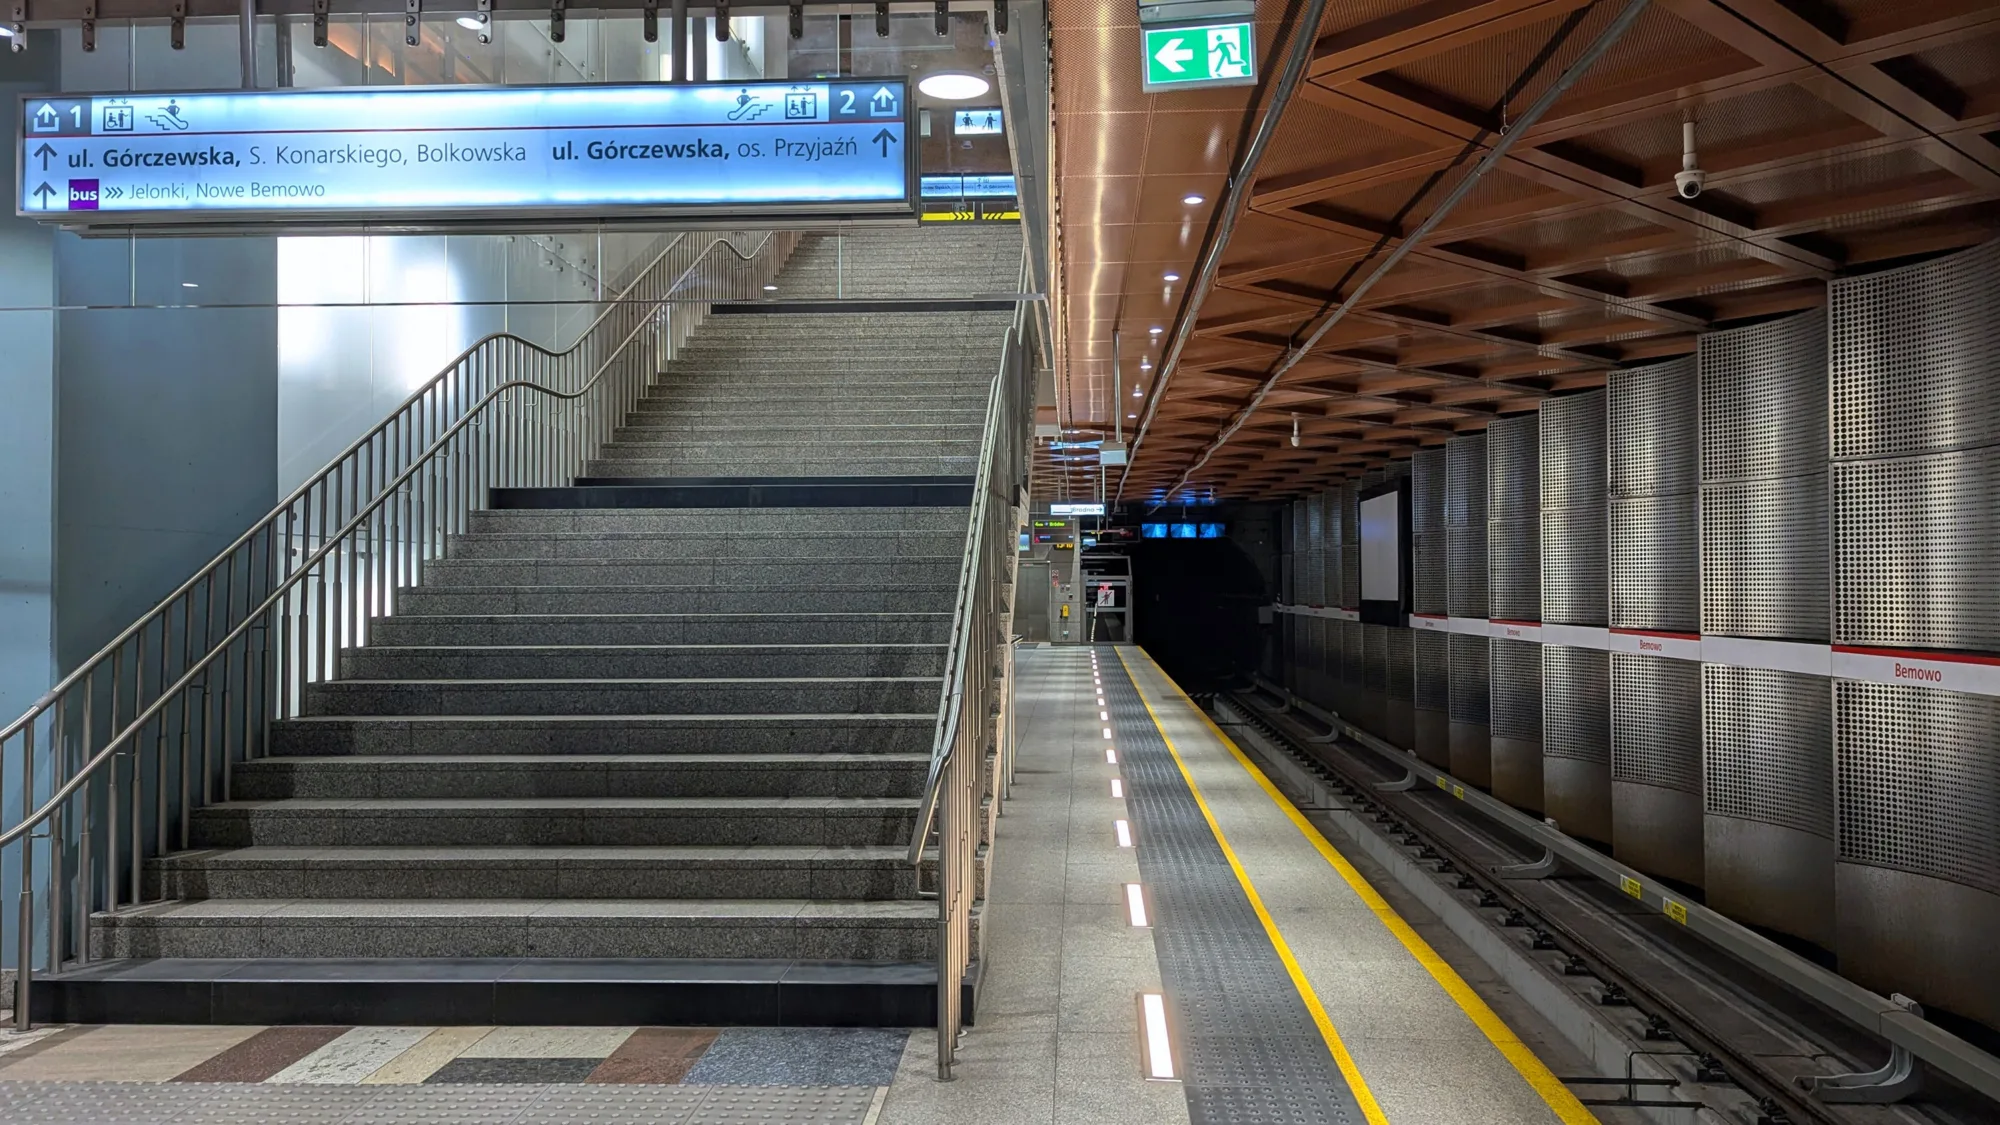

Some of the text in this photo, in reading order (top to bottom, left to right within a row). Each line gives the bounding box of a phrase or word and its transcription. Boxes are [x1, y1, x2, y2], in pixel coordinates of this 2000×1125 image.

[839, 89, 856, 114] 2
[69, 105, 82, 128] 1
[68, 142, 526, 169] ul. Górczewska, S. Konarskiego, Bolkowska
[552, 136, 857, 162] ul. Górczewska, os. Przyjaźń
[69, 187, 98, 203] bus
[129, 180, 325, 201] Jelonki, Nowe Bemowo
[1639, 640, 1663, 652] Bemowo
[1895, 662, 1942, 683] Bemowo
